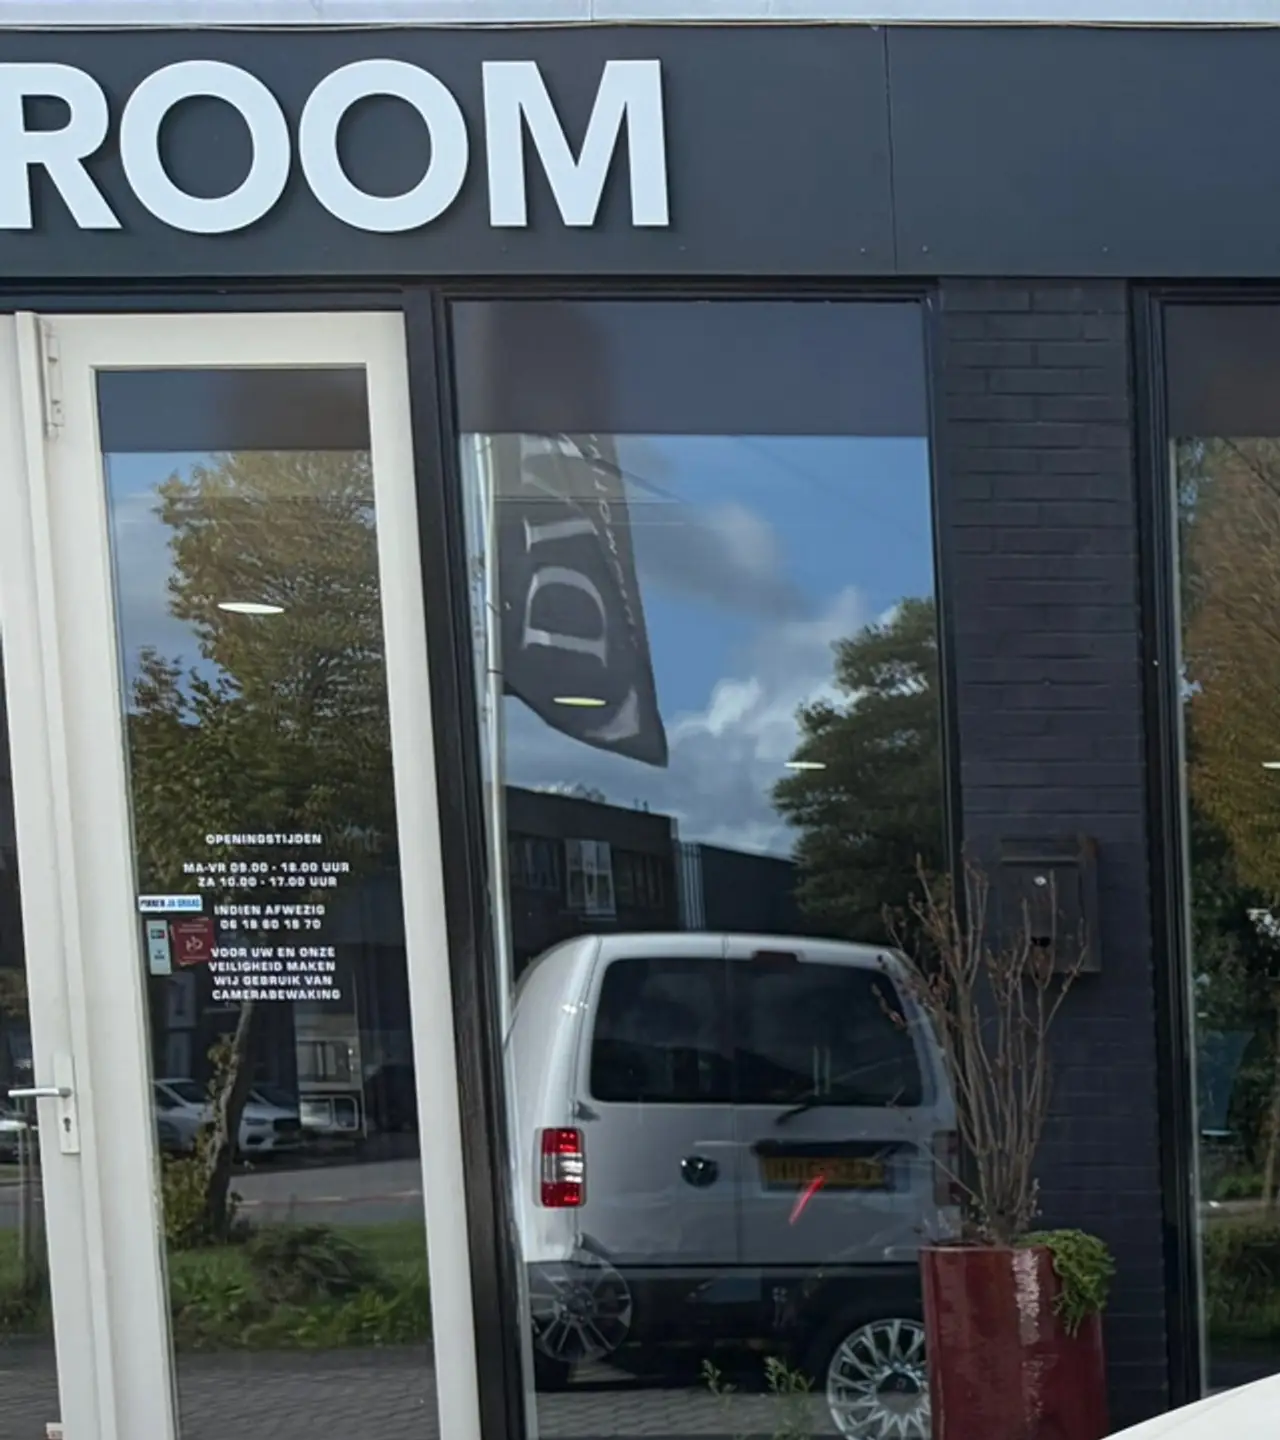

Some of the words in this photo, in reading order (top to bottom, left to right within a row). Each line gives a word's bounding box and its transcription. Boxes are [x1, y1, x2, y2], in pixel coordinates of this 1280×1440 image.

[0, 59, 669, 233] ROOM
[205, 833, 323, 845] OPENINGSTIJDEN
[183, 862, 226, 873] MA-VR
[322, 862, 350, 873] UUR
[198, 876, 216, 888] ZA
[219, 876, 258, 887] 10.00
[269, 876, 306, 887] 17.00
[309, 876, 338, 887] UUR
[214, 904, 261, 916] INDIEN
[265, 904, 326, 916] AFWEZIG
[210, 947, 248, 958] VOOR
[251, 947, 273, 958] UW
[277, 947, 296, 958] EN
[299, 946, 336, 958] ONZE
[208, 961, 283, 972] VEILIGHEID
[286, 961, 336, 972] MAKEN
[213, 976, 239, 986] WIJ
[242, 975, 301, 986] GEBRUIK
[304, 975, 333, 986] VAN
[212, 989, 342, 1001] CAMERABEWAKING
